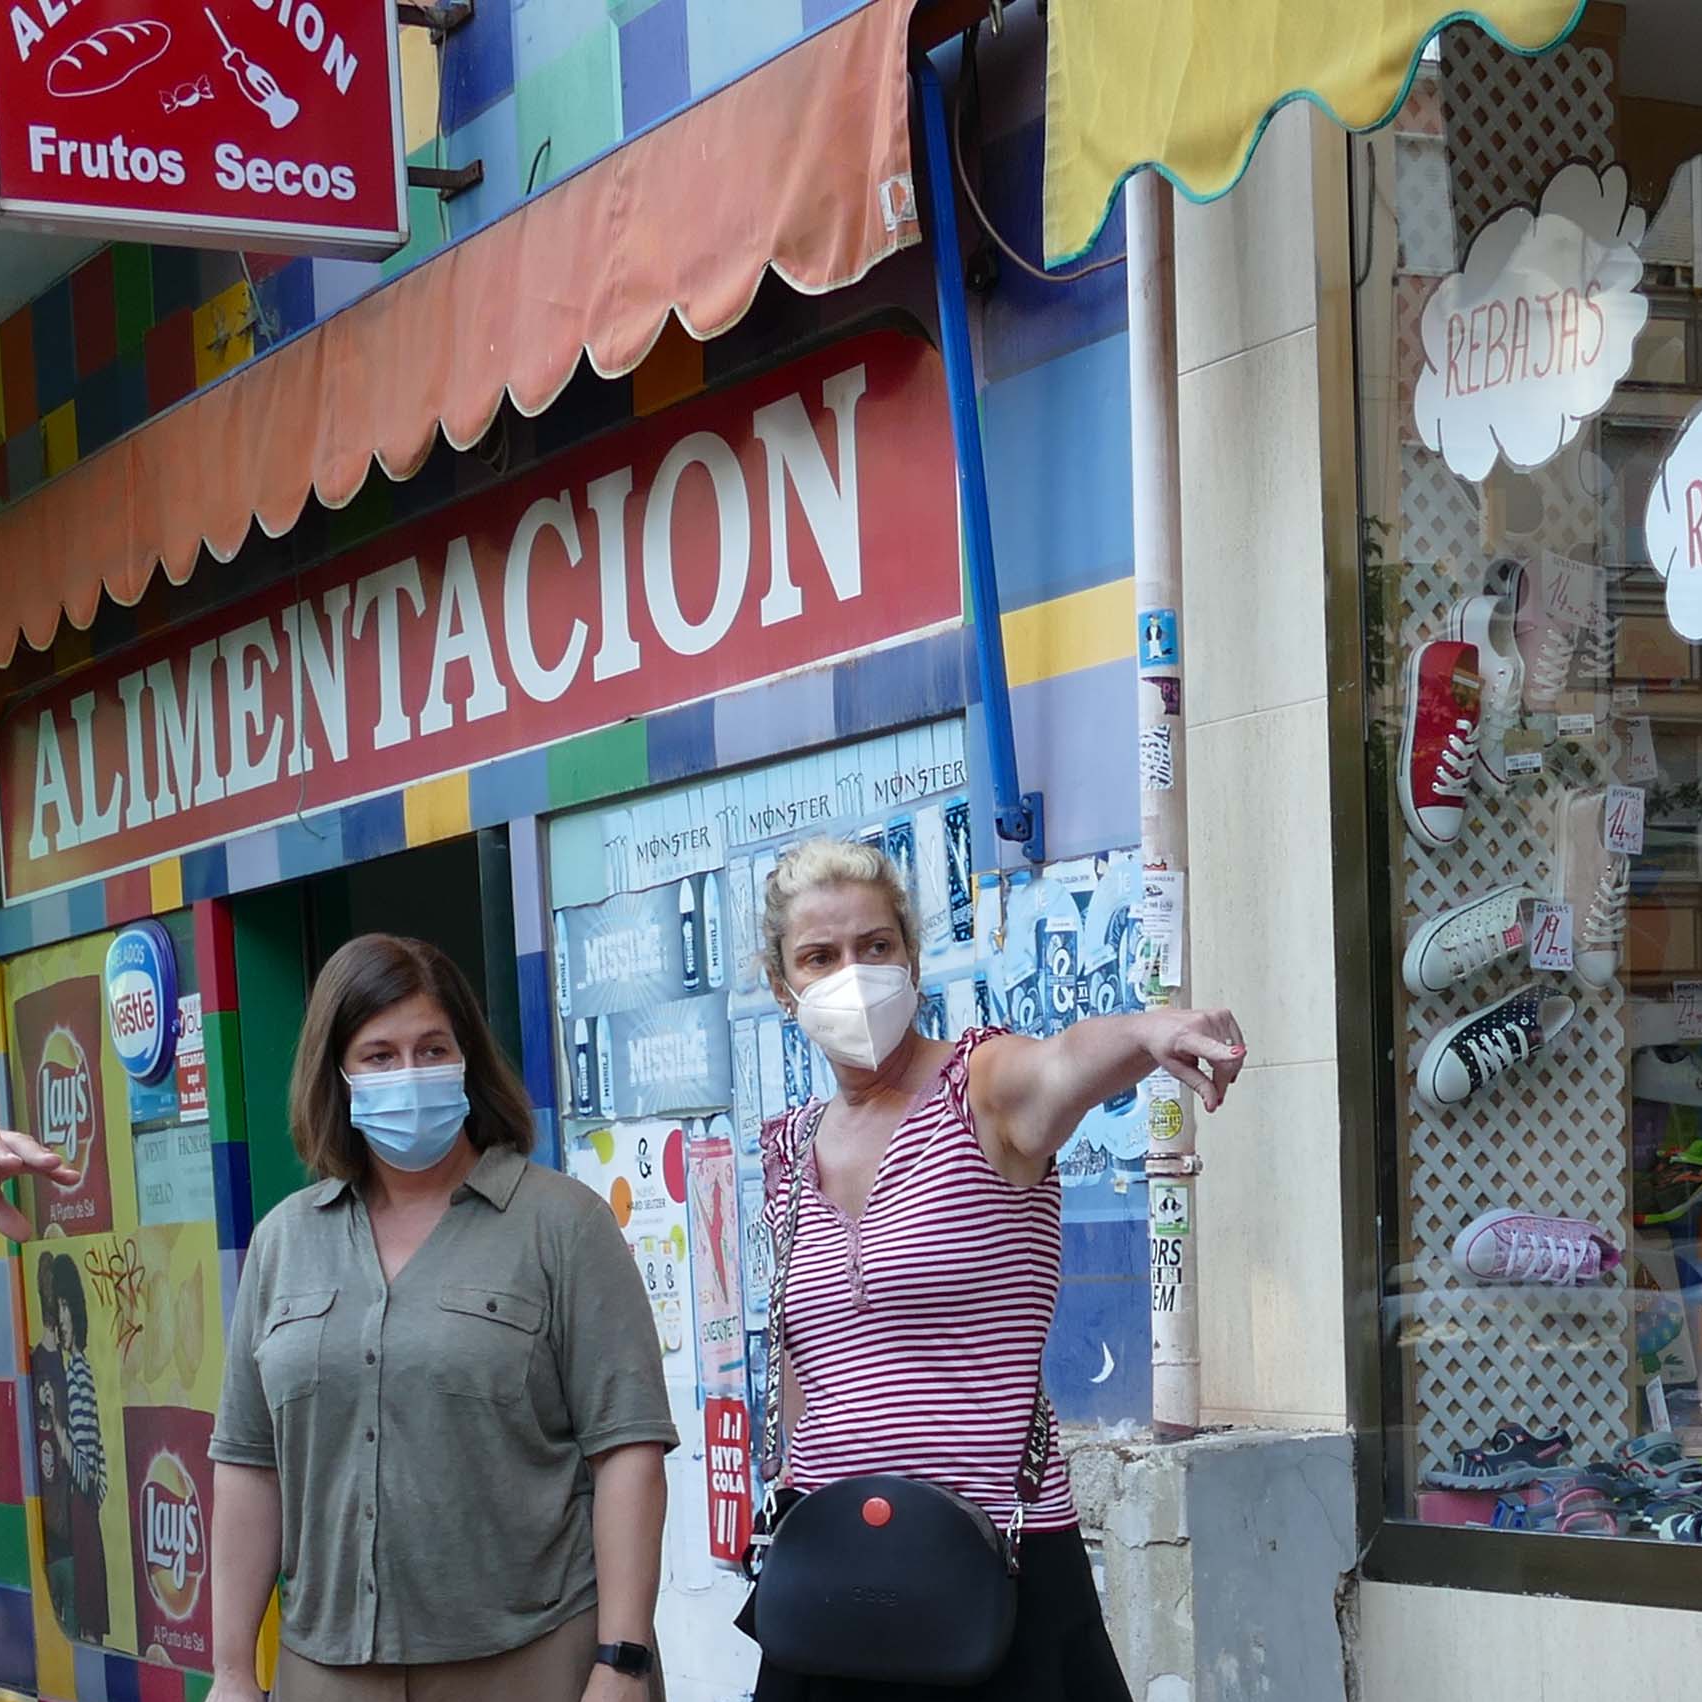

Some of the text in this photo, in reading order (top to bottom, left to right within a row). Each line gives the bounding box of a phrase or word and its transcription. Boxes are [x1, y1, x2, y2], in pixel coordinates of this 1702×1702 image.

[28, 125, 356, 200] Frutos Secos
[1445, 280, 1604, 399] REBAJAS
[26, 364, 867, 861] ALIMENTACION
[874, 759, 967, 804] MONSTER
[749, 794, 832, 836] MONSTER
[636, 826, 711, 863] MONSTER
[712, 1473, 745, 1494] COLA
[145, 1494, 200, 1591] Lay's
[153, 1624, 205, 1652] Al Punto de Sal
